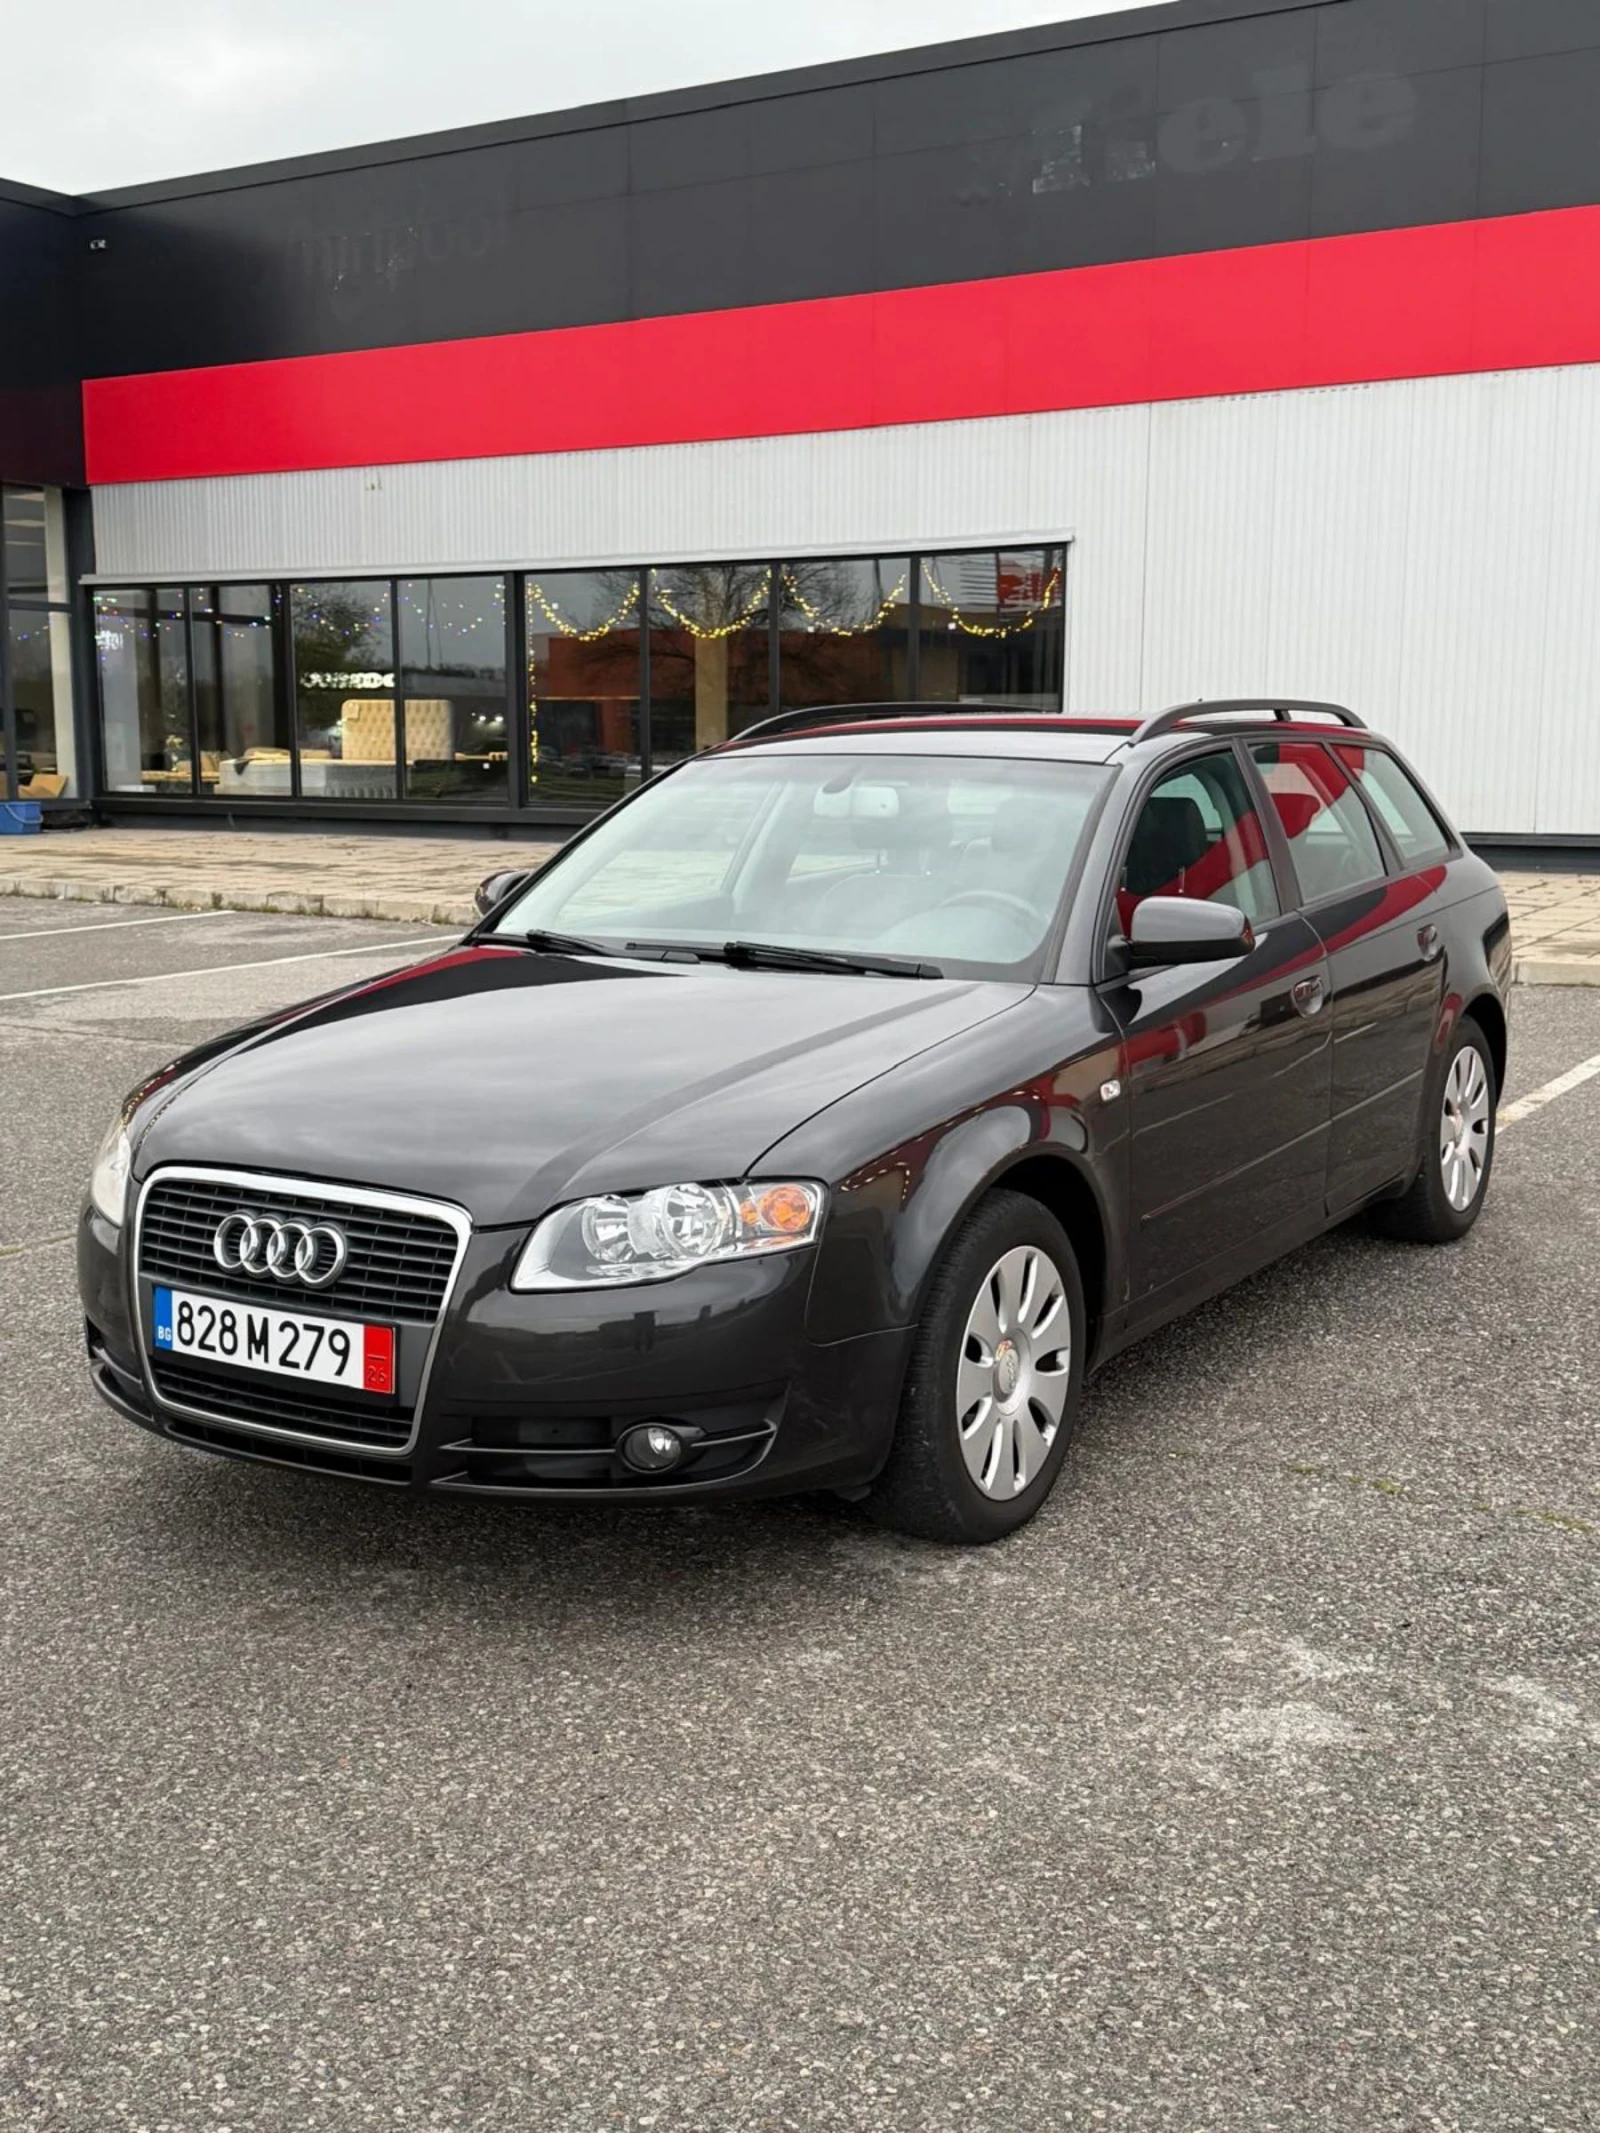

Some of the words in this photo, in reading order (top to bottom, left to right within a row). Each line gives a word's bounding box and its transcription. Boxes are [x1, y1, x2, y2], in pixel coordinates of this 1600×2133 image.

[157, 1325, 172, 1342] BG
[177, 1301, 238, 1356] 828
[247, 1314, 269, 1364] M
[279, 1321, 350, 1376] 279
[367, 1365, 386, 1384] 26
